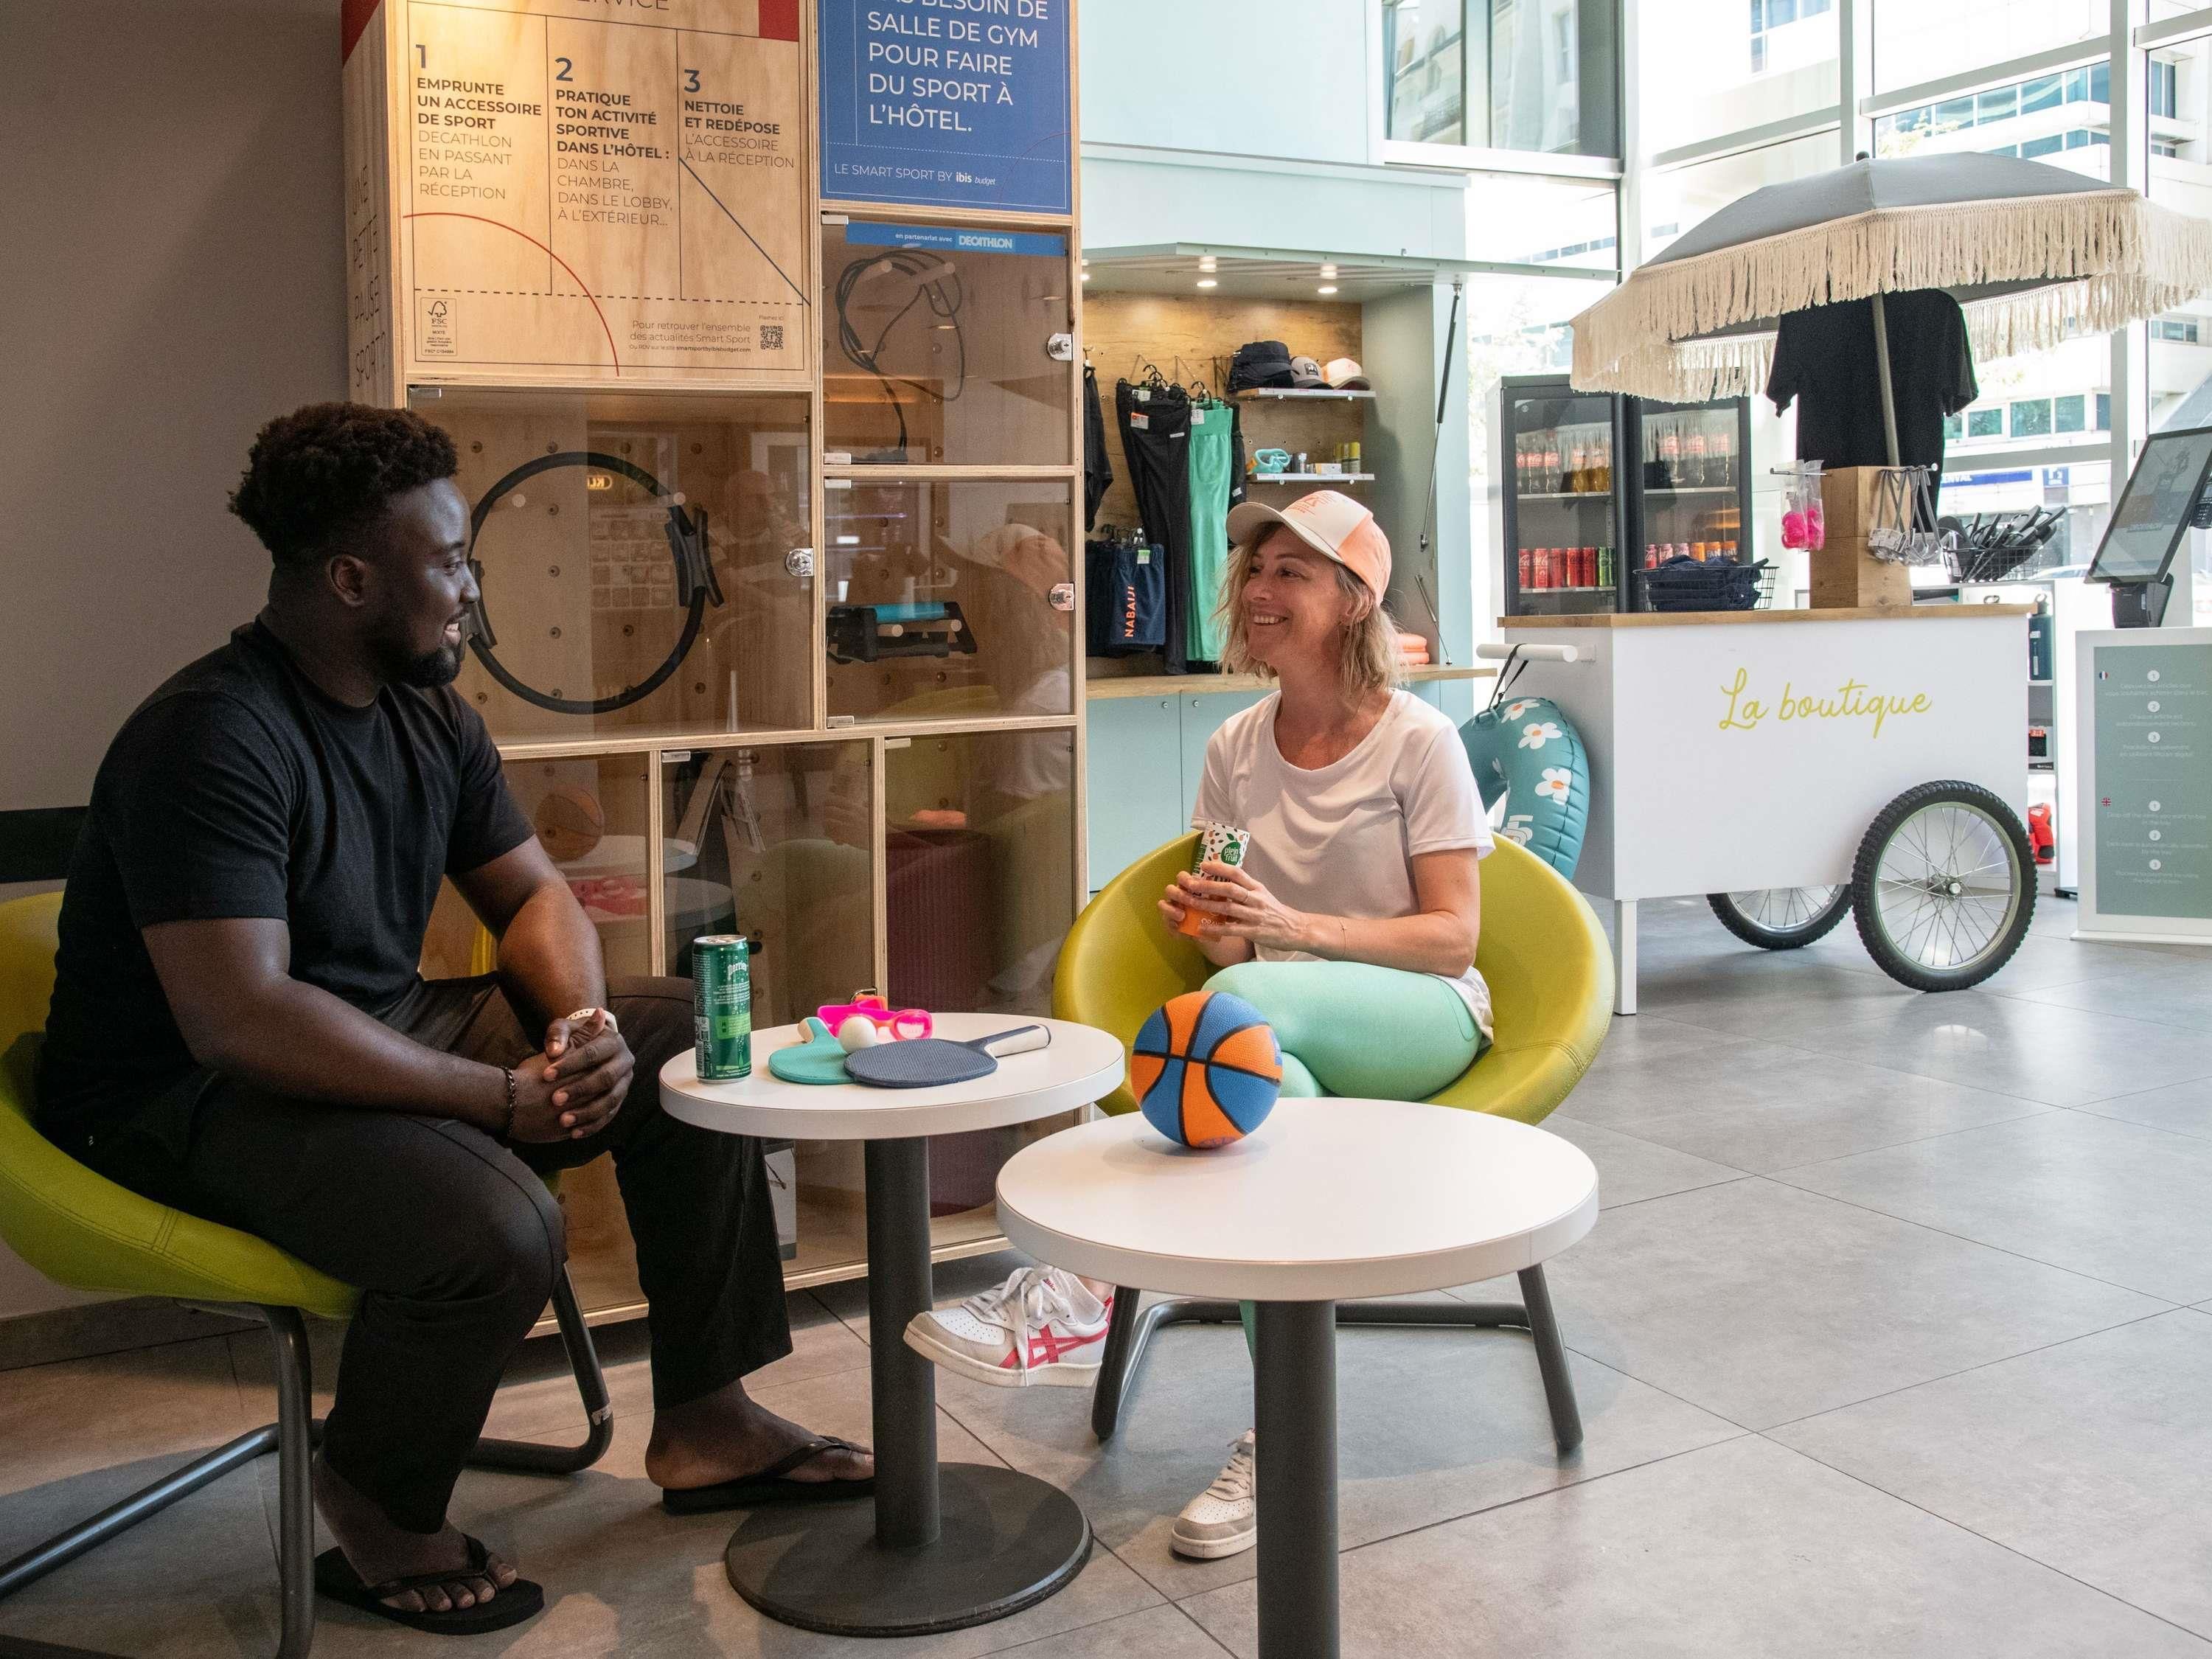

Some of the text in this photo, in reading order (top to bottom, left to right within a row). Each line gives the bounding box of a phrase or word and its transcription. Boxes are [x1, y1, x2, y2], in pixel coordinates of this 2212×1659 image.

[1018, 1, 1048, 20] DE
[868, 12, 1038, 48] SALLE DE GYM
[416, 44, 426, 69] 1
[869, 42, 1012, 76] POUR FAIRE
[554, 58, 573, 82] 2
[417, 77, 504, 96] EMPRUNTE
[684, 69, 700, 93] 3
[869, 74, 1014, 105] DU SPORT À
[417, 95, 542, 116] UN ACCESSOIRE
[556, 89, 631, 106] PRATIQUE
[556, 106, 657, 125] TON ACTIVITÉ
[684, 100, 744, 116] NETTOIE
[418, 113, 496, 130] DE SPORT
[556, 123, 630, 139] SPORTIVE
[685, 116, 781, 135] ET REDÉPOSE
[419, 131, 512, 148] DECATHLON
[557, 141, 599, 154] DANS
[419, 148, 512, 166] EN PASSANT
[557, 158, 620, 173] DANS LA
[685, 150, 795, 169] À LA RÉCEPTION
[419, 166, 473, 180] PAR LA
[835, 163, 996, 186] LE SMART SPORT BY ibis budget
[420, 181, 506, 200] RÉCEPTION
[557, 175, 634, 192] CHAMBRE,
[557, 192, 673, 211] DANS LE LOBBY,
[557, 207, 568, 220] À
[904, 234, 937, 243] partenariat
[959, 235, 1012, 248] DECATHLON
[633, 320, 655, 330] Pour
[657, 322, 700, 331] retrouver
[630, 331, 647, 341] des
[695, 334, 724, 344] Smart
[726, 335, 751, 345] Sport
[1124, 586, 1135, 638] NABAIJI
[1719, 667, 1933, 739] La boutique
[1224, 846, 1239, 857] plein
[1225, 853, 1237, 862] fruit
